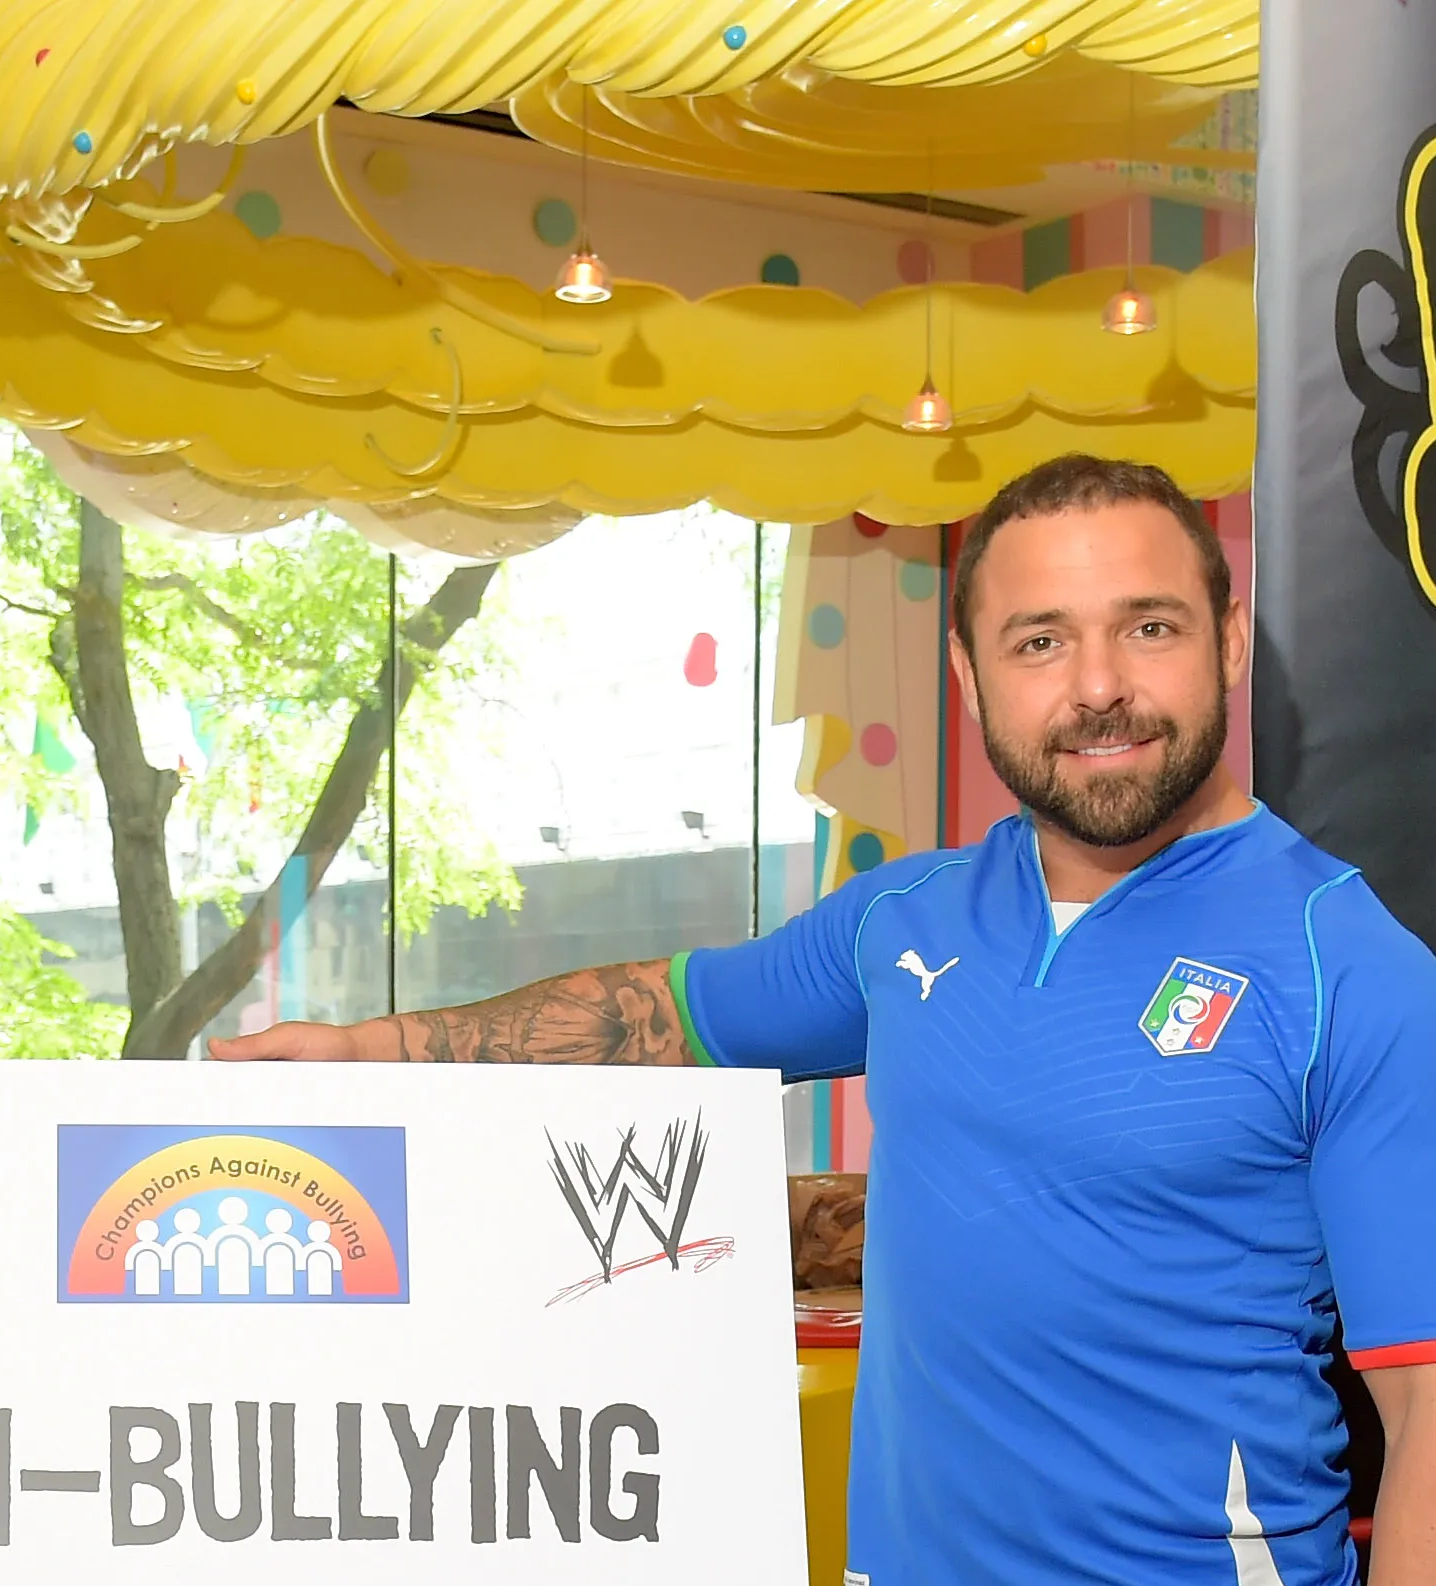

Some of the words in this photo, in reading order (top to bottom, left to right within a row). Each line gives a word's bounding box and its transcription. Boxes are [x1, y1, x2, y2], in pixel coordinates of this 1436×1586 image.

[1179, 968, 1231, 994] ITALIA
[96, 1160, 201, 1262] Champions
[207, 1155, 303, 1190] Against
[301, 1179, 368, 1262] Bullying
